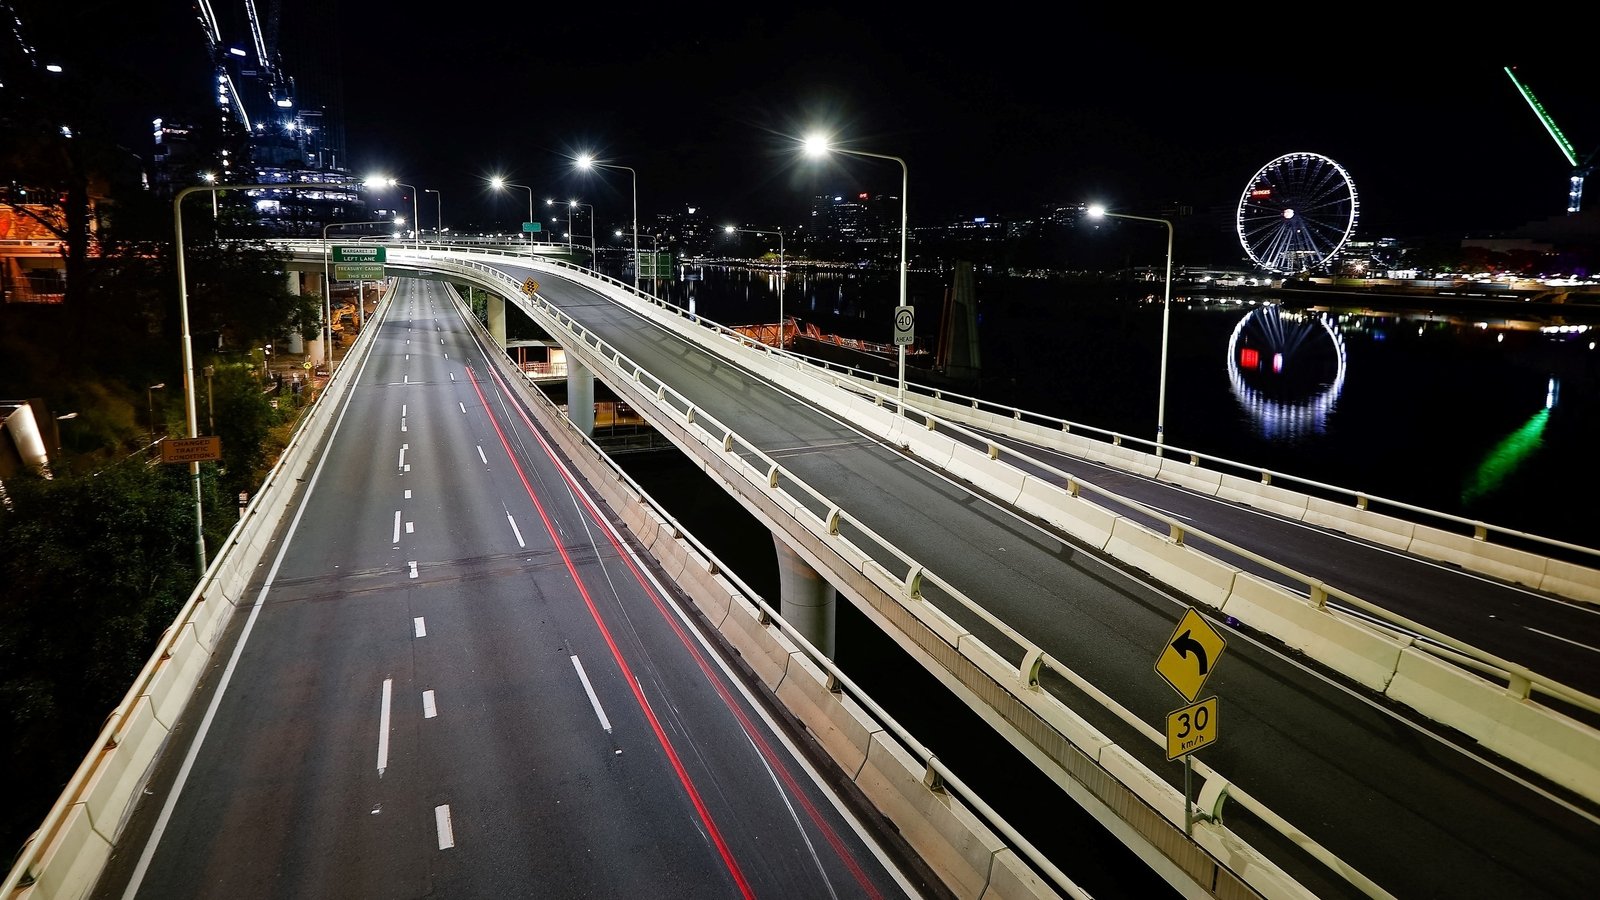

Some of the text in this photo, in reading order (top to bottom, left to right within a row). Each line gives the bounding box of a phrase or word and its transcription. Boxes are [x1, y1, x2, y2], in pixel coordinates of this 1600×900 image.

[898, 316, 911, 326] 40
[1177, 706, 1208, 738] 30
[1182, 735, 1204, 750] km/h
